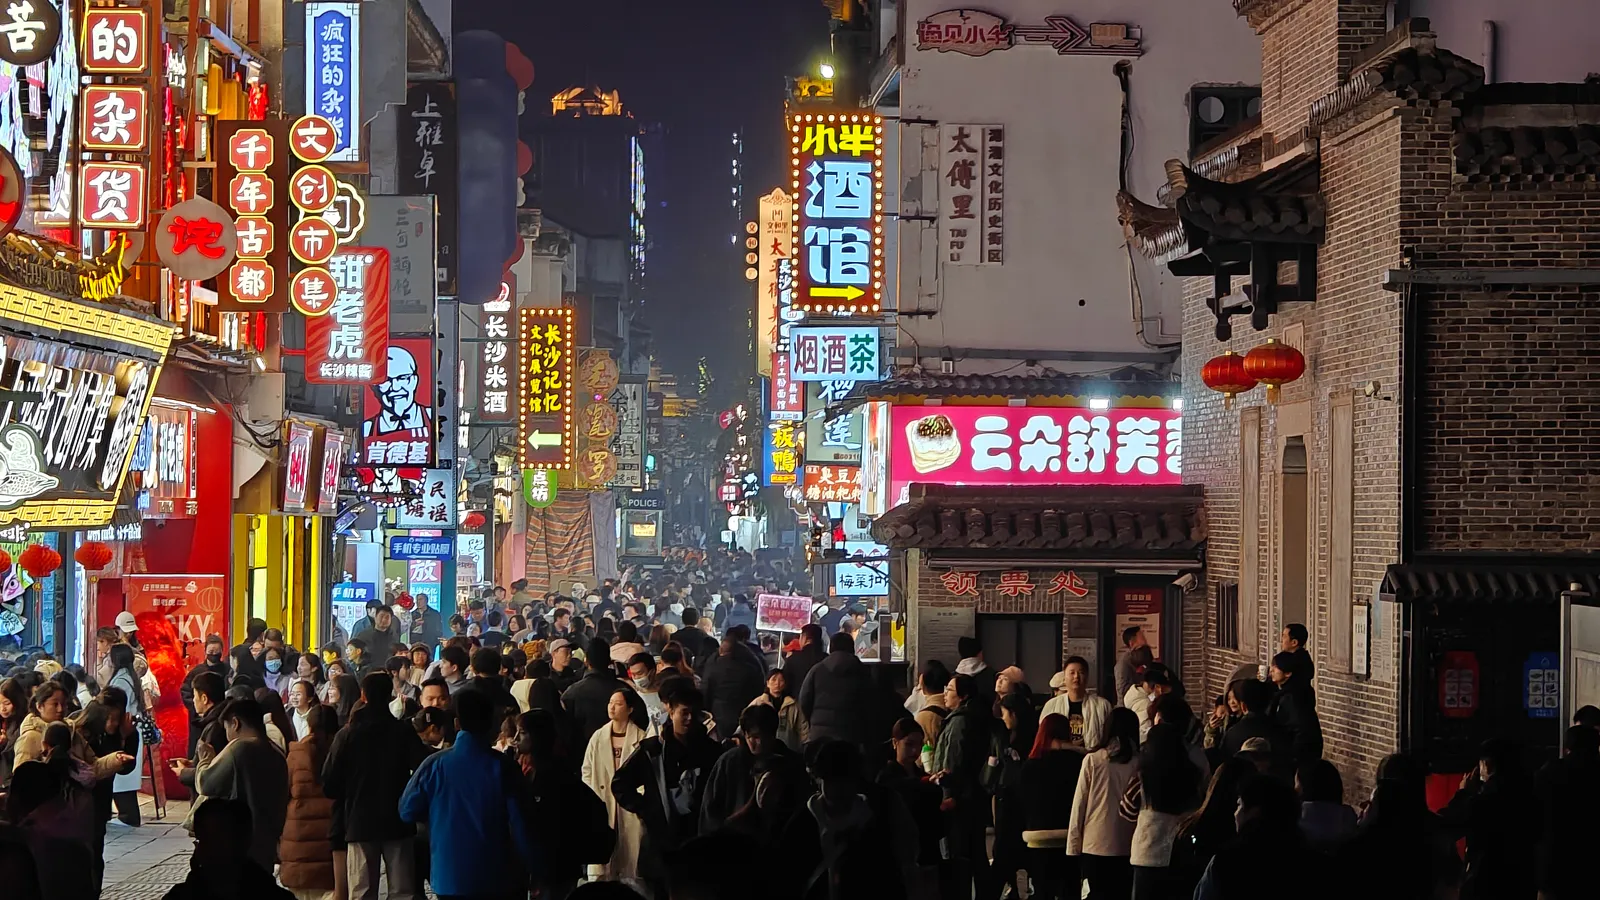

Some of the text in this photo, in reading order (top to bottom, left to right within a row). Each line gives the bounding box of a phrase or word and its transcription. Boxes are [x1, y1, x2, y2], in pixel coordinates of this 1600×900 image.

[0, 1, 46, 53] 苦
[89, 17, 138, 221] 的杂货
[801, 124, 875, 156] 小半
[945, 126, 978, 219] 太傅里
[236, 135, 267, 297] 千年古都
[296, 120, 331, 309] 文创市集
[804, 160, 873, 284] 酒馆
[327, 254, 364, 359] 甜老虎
[320, 362, 374, 379] 长沙辣酱
[484, 315, 508, 414] 长沙米酒
[529, 324, 543, 413] 文化展览馆
[543, 323, 562, 413] 长沙记忆
[794, 333, 875, 374] 烟酒茶
[368, 441, 430, 465] 肯德基
[771, 427, 796, 473] 板鸭
[971, 415, 1182, 475] 云朵舒芙
[428, 480, 448, 523] 民谣
[628, 499, 657, 507] POLICE
[393, 543, 450, 555] 手机专业贴膜
[409, 559, 438, 582] 放
[940, 571, 1089, 597] 领票处
